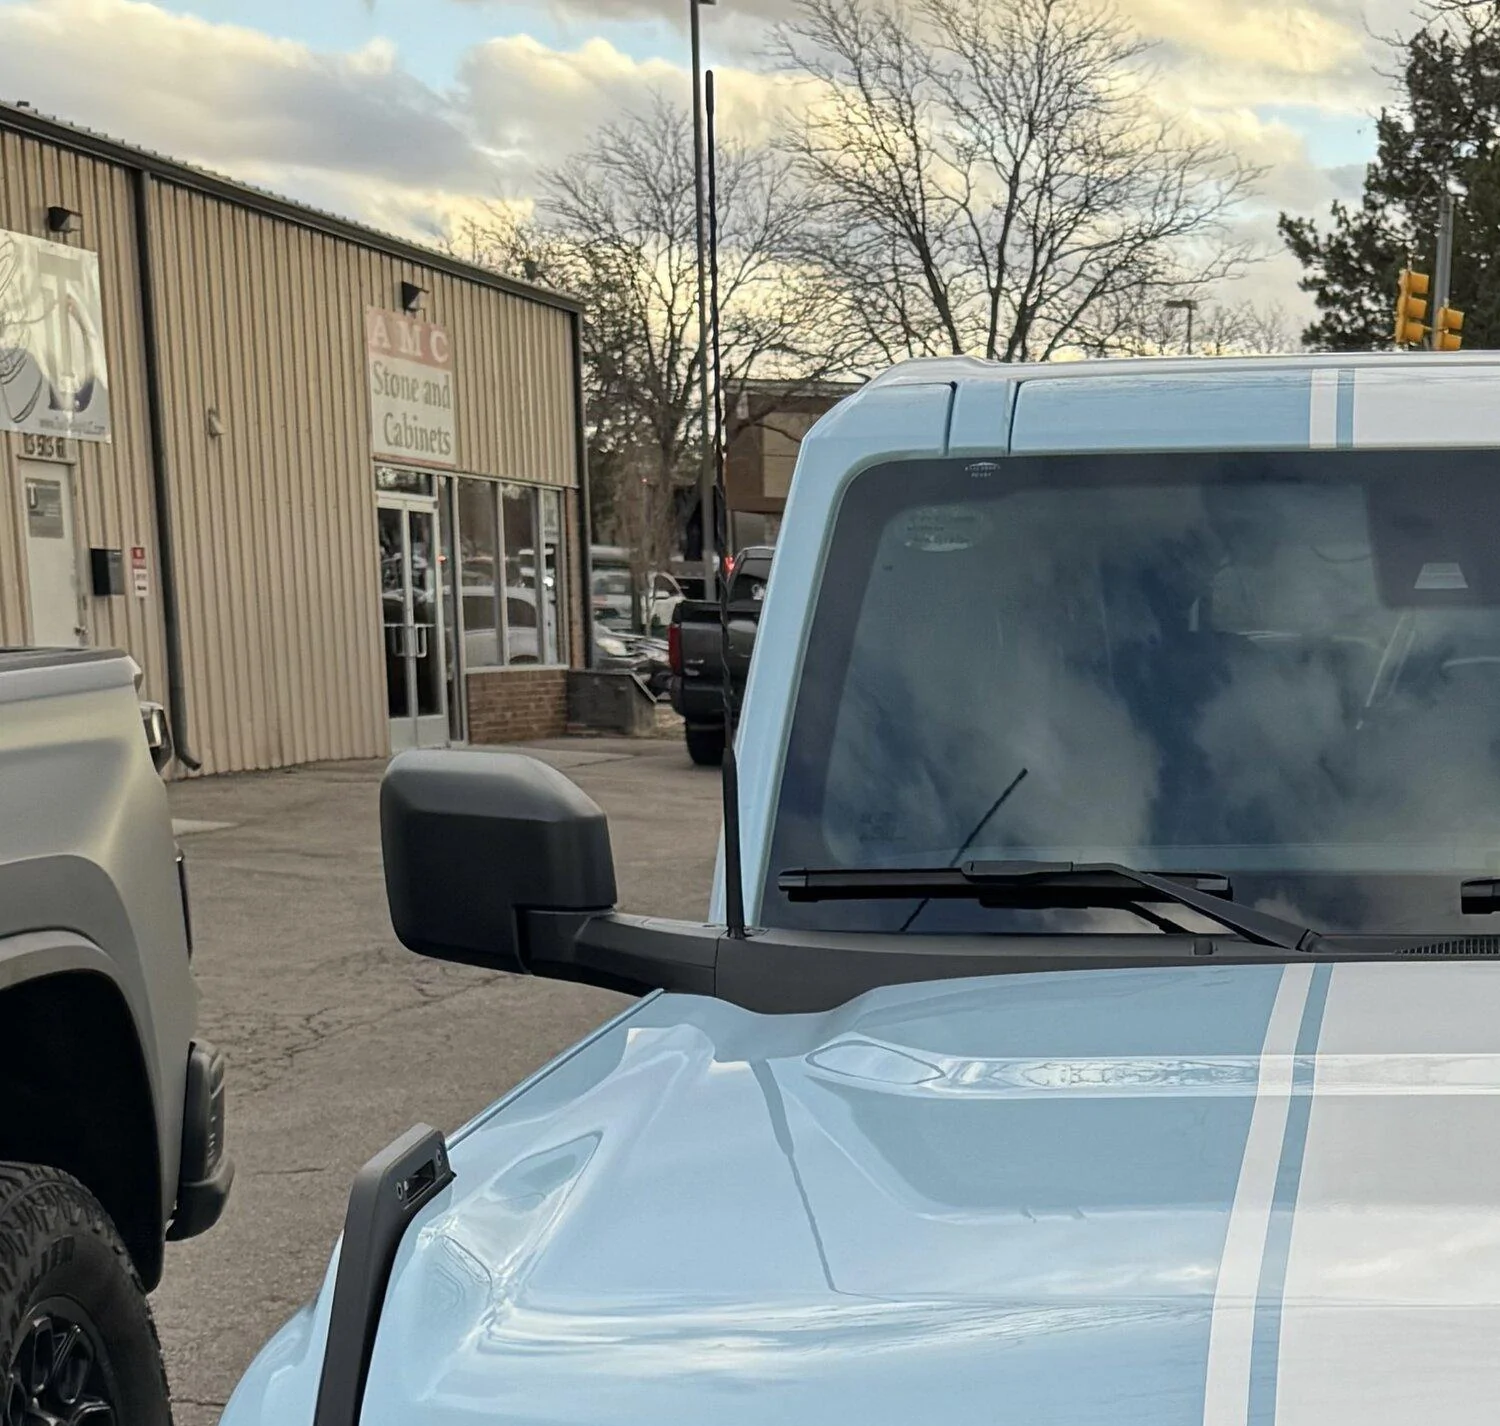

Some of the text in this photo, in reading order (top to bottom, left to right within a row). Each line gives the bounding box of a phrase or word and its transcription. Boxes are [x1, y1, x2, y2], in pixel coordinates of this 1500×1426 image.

[373, 360, 451, 409] Stone and
[383, 412, 451, 456] Cabinets
